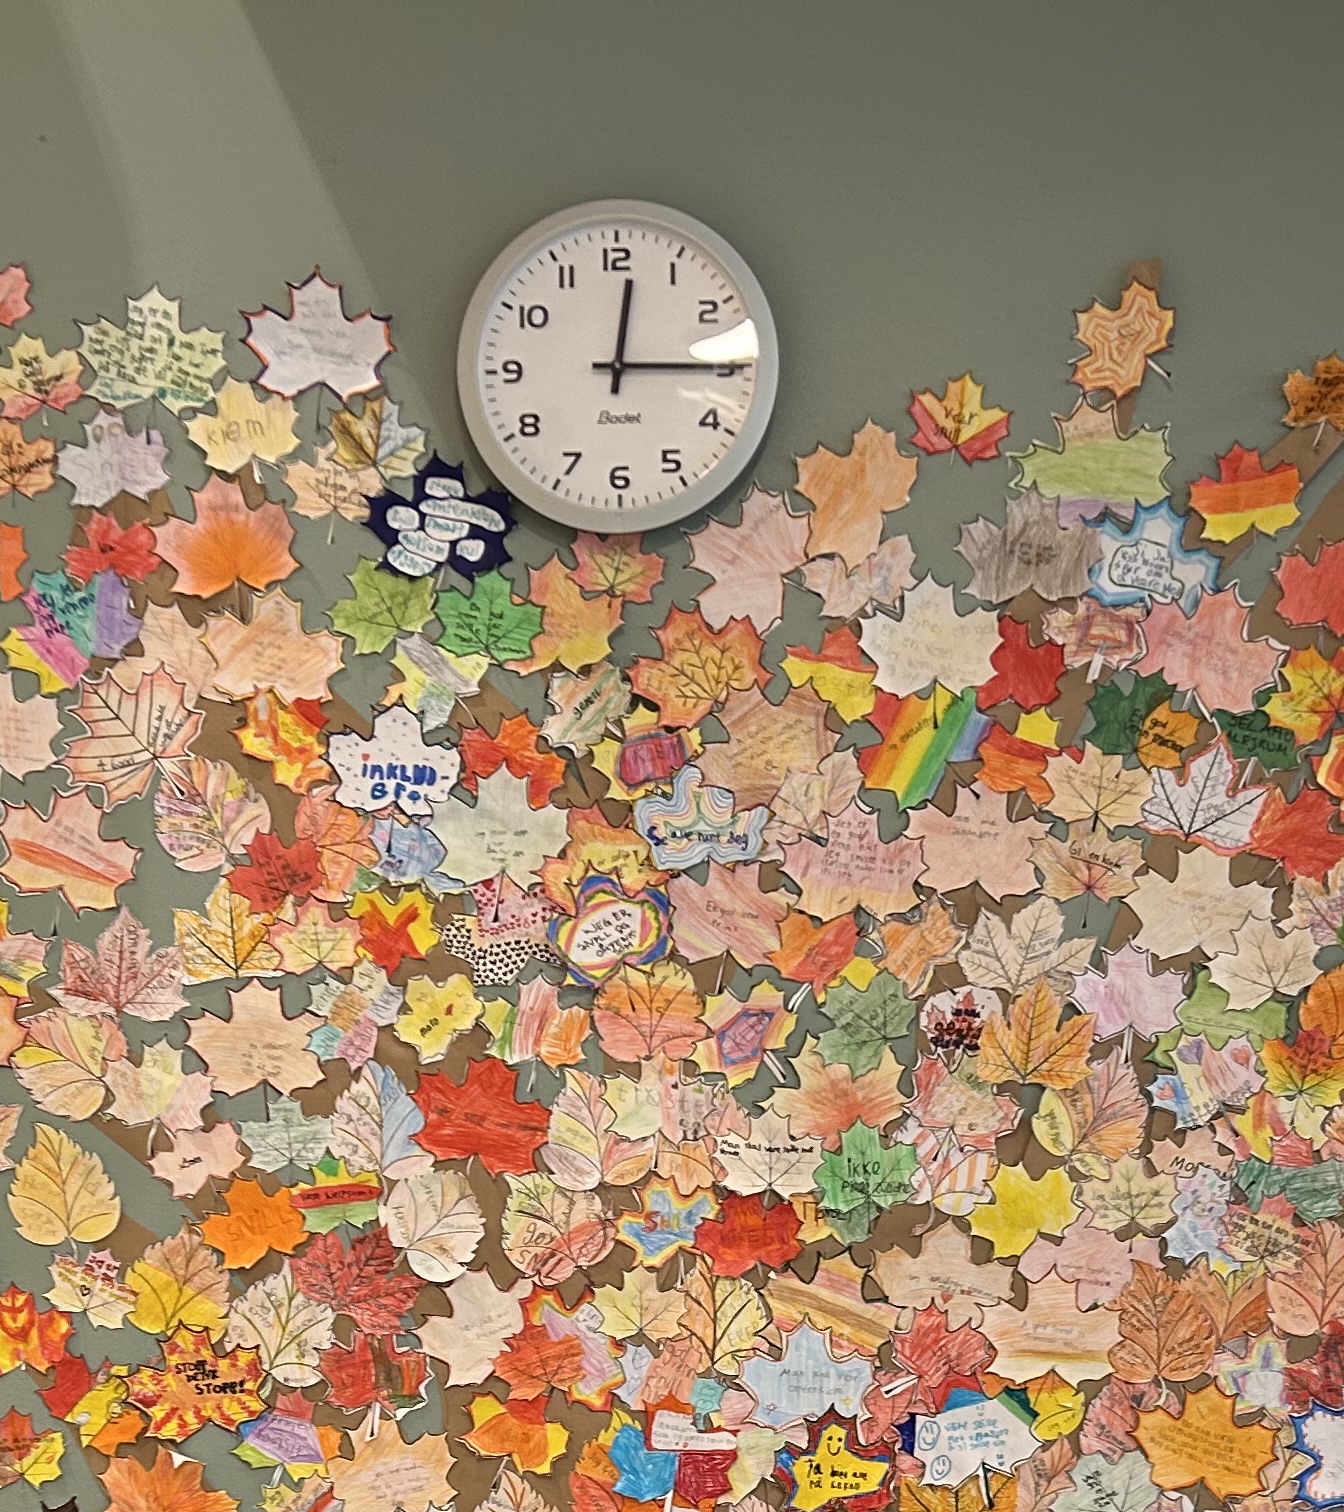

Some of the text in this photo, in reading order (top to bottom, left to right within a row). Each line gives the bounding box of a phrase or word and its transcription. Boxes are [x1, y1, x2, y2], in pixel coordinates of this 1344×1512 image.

[602, 247, 632, 272] 12
[558, 264, 575, 289] 11
[670, 261, 677, 286] 1
[519, 304, 549, 329] 10
[698, 300, 718, 324] 2
[501, 360, 523, 384] 9
[519, 413, 540, 437] 8
[596, 409, 642, 426] Bodet
[698, 407, 721, 431] 4
[562, 452, 582, 476] 7
[661, 449, 682, 473] 5
[609, 466, 630, 490] 6
